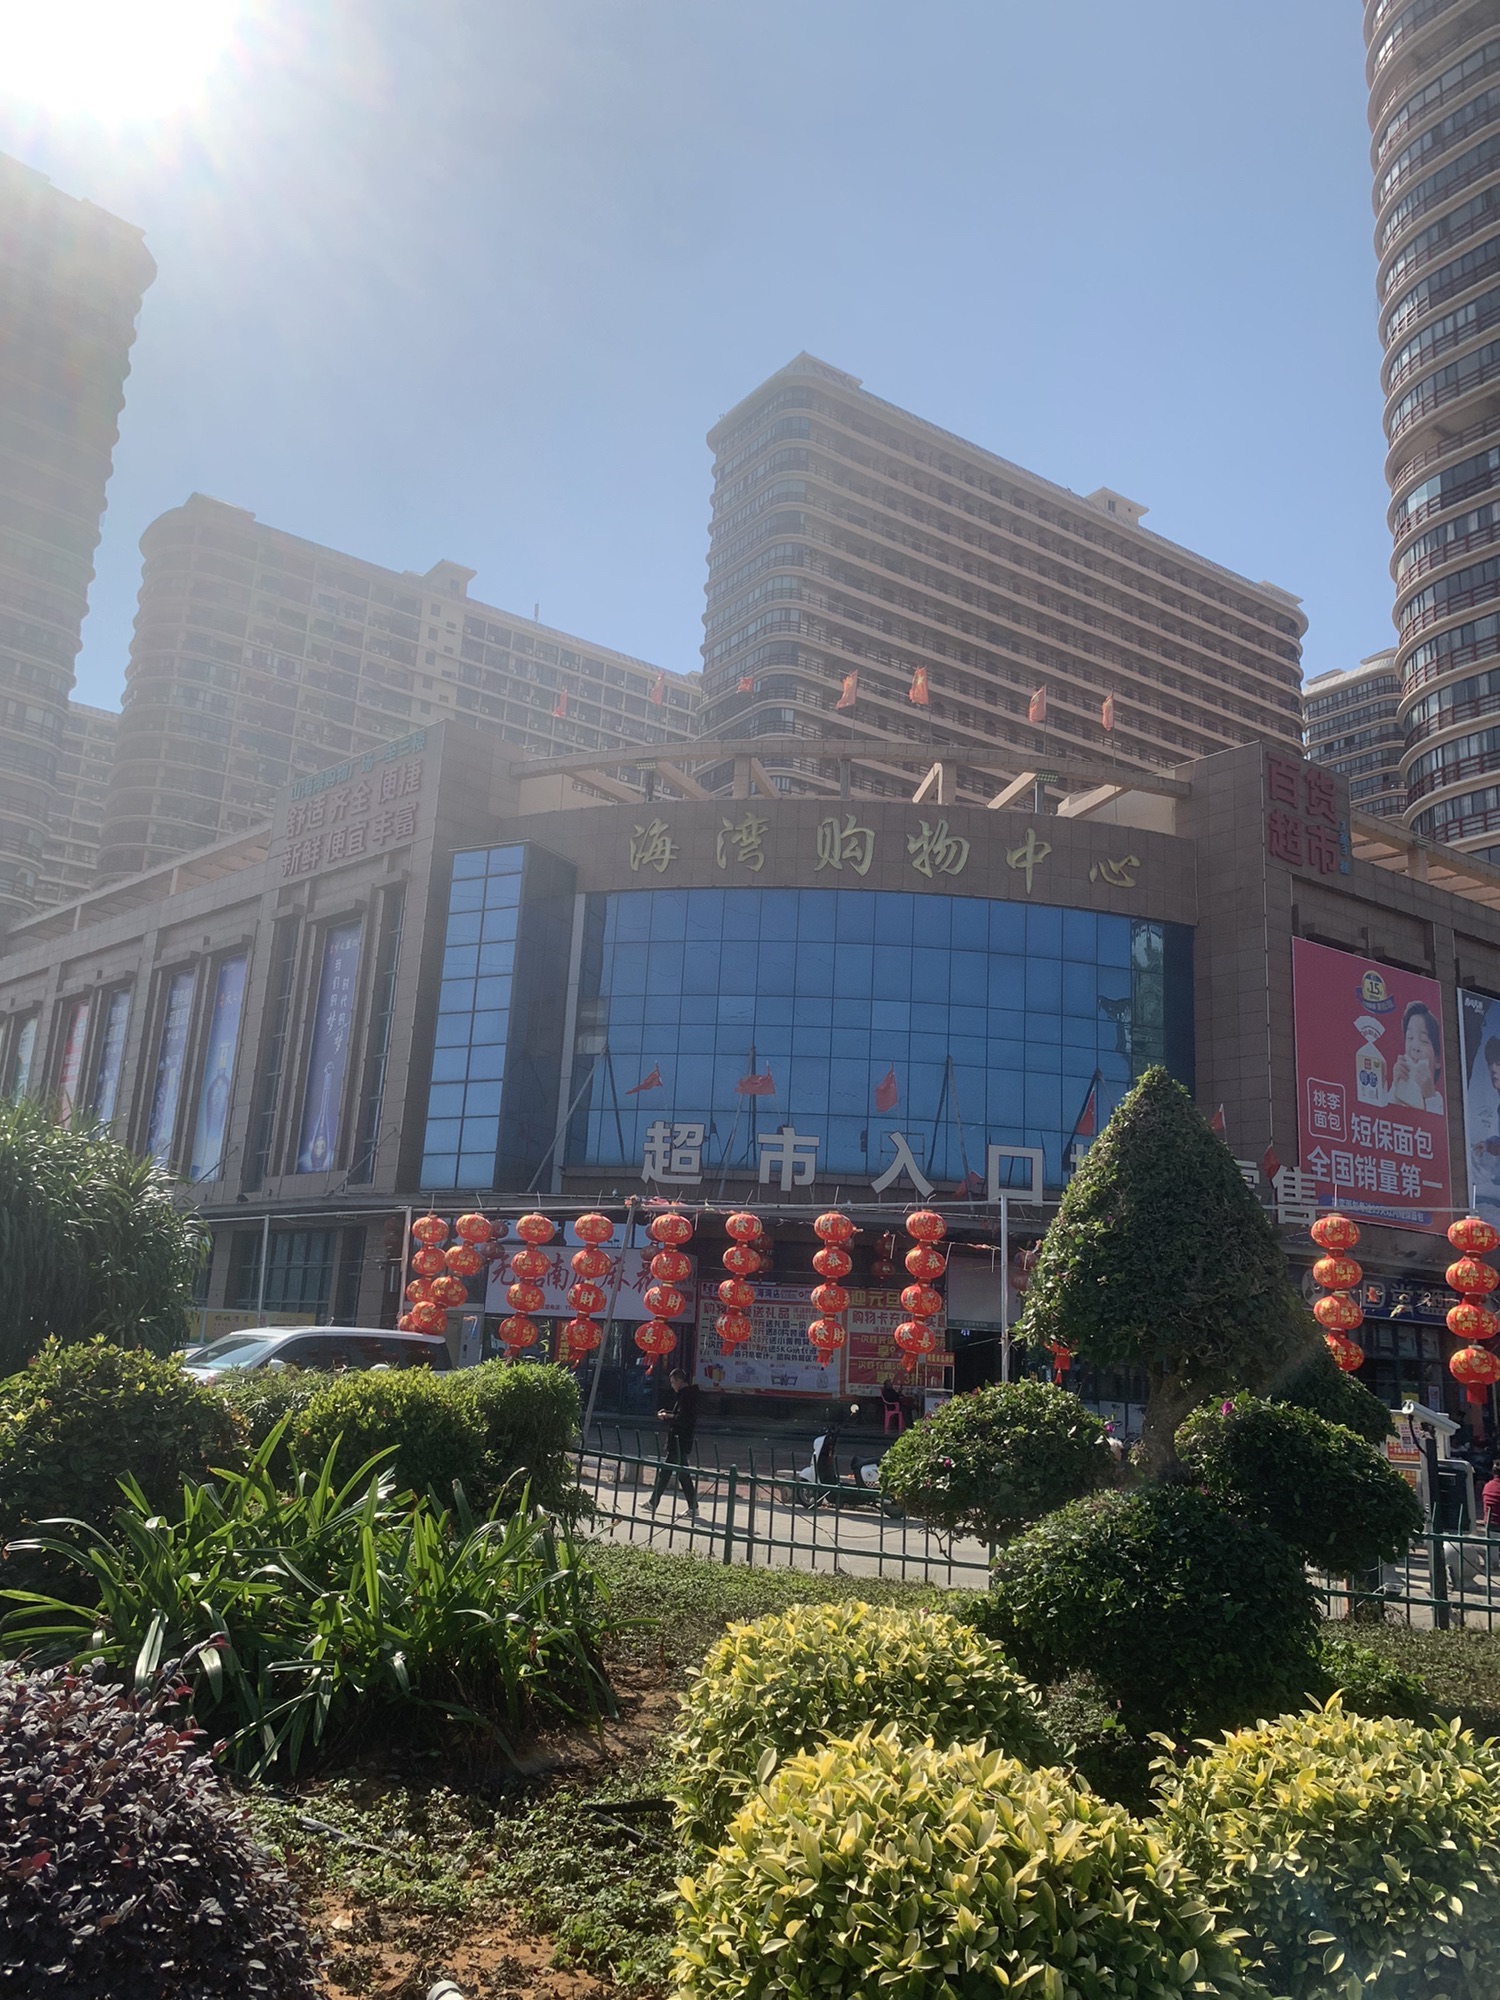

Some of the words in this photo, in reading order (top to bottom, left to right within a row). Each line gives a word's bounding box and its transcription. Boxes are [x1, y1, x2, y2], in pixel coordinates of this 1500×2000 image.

[1266, 751, 1336, 824] 百货
[281, 836, 322, 877] 新鲜
[327, 821, 368, 863] 便宜
[372, 802, 419, 846] 丰富
[629, 812, 1141, 895] 海湾购物中心
[1269, 808, 1339, 875] 超市
[1312, 1090, 1340, 1110] 桃李
[1313, 1109, 1342, 1131] 面包
[1350, 1112, 1434, 1160] 短保面包
[1306, 1145, 1443, 1198] 全国销量第一
[850, 1290, 901, 1308] 迎元旦
